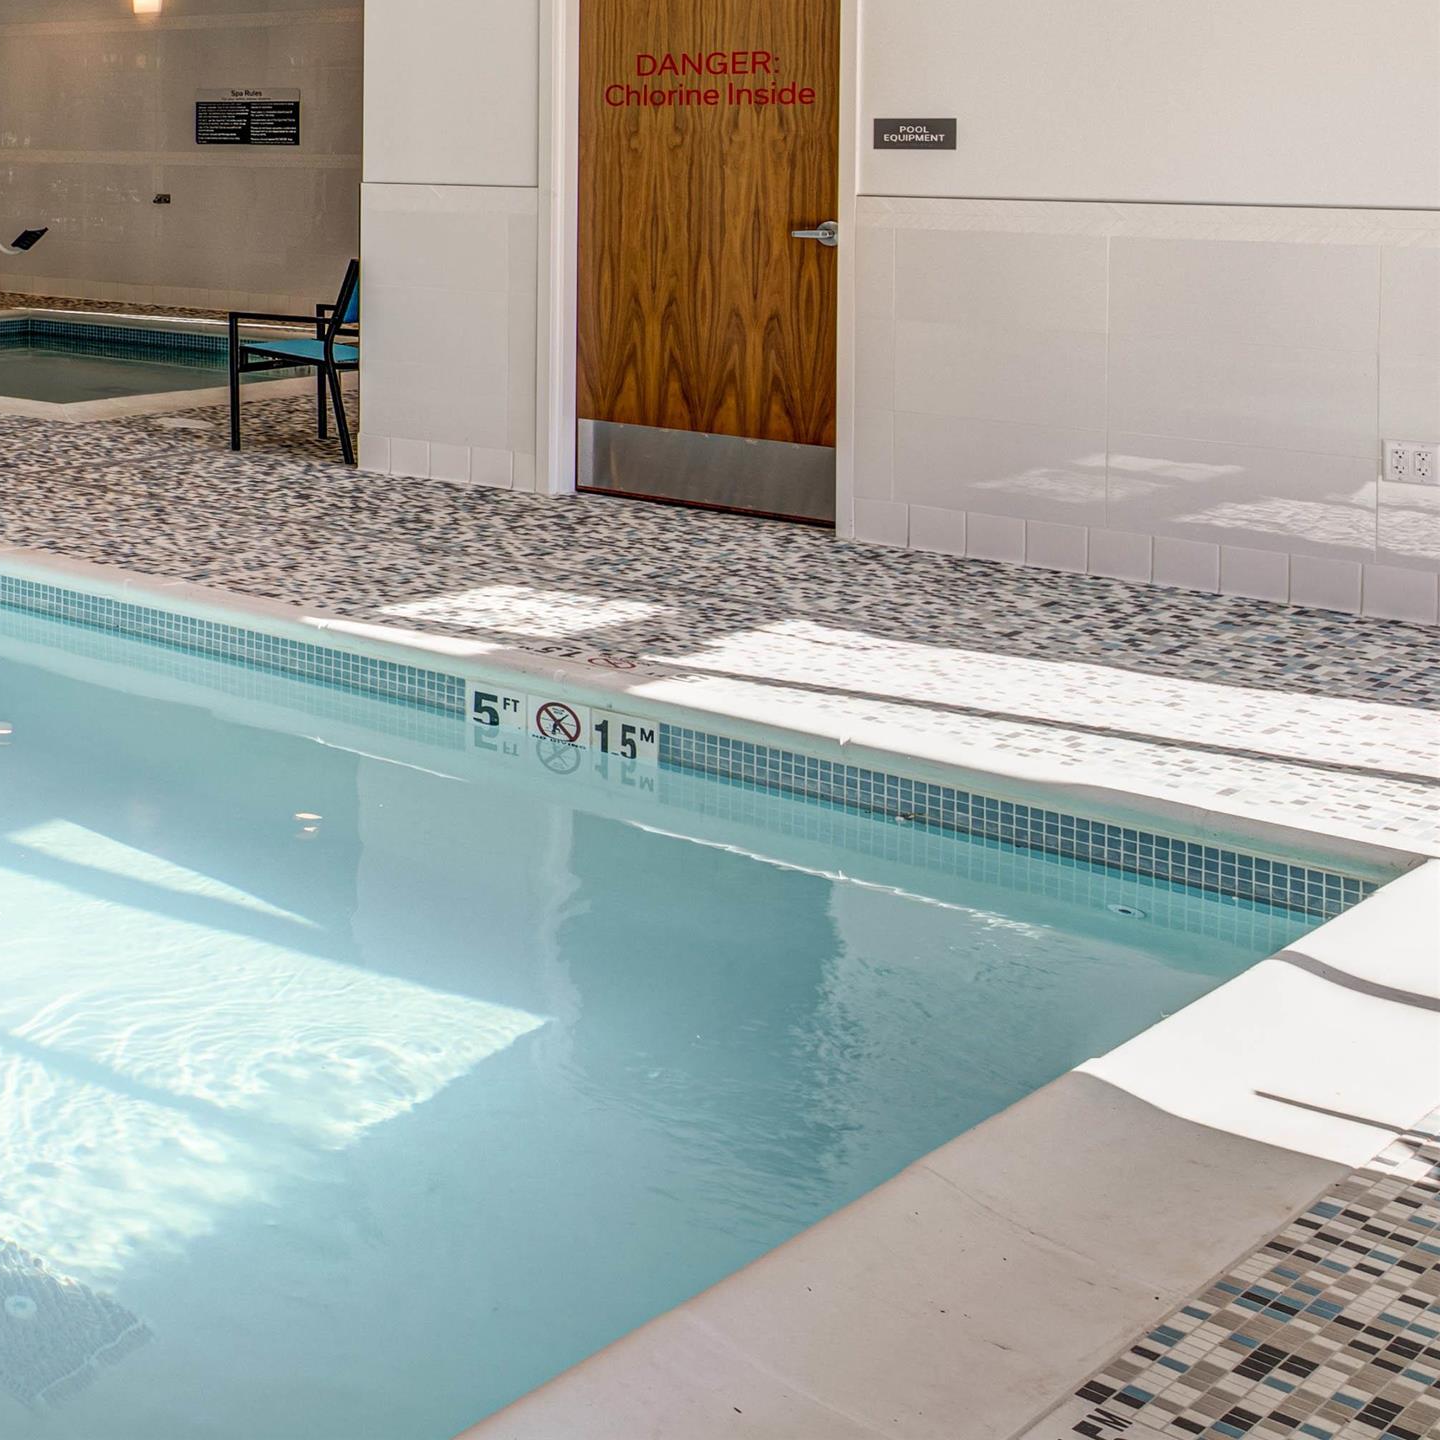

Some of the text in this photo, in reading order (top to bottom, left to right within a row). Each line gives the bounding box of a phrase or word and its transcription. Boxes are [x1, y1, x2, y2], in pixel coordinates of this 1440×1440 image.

[637, 51, 779, 76] DANGER:
[231, 89, 262, 97] Spa Rules
[605, 81, 815, 106] Chlorine Inside
[883, 134, 945, 142] EQUIPMENT
[473, 691, 499, 726] 5
[503, 697, 520, 712] FT
[640, 727, 655, 744] M
